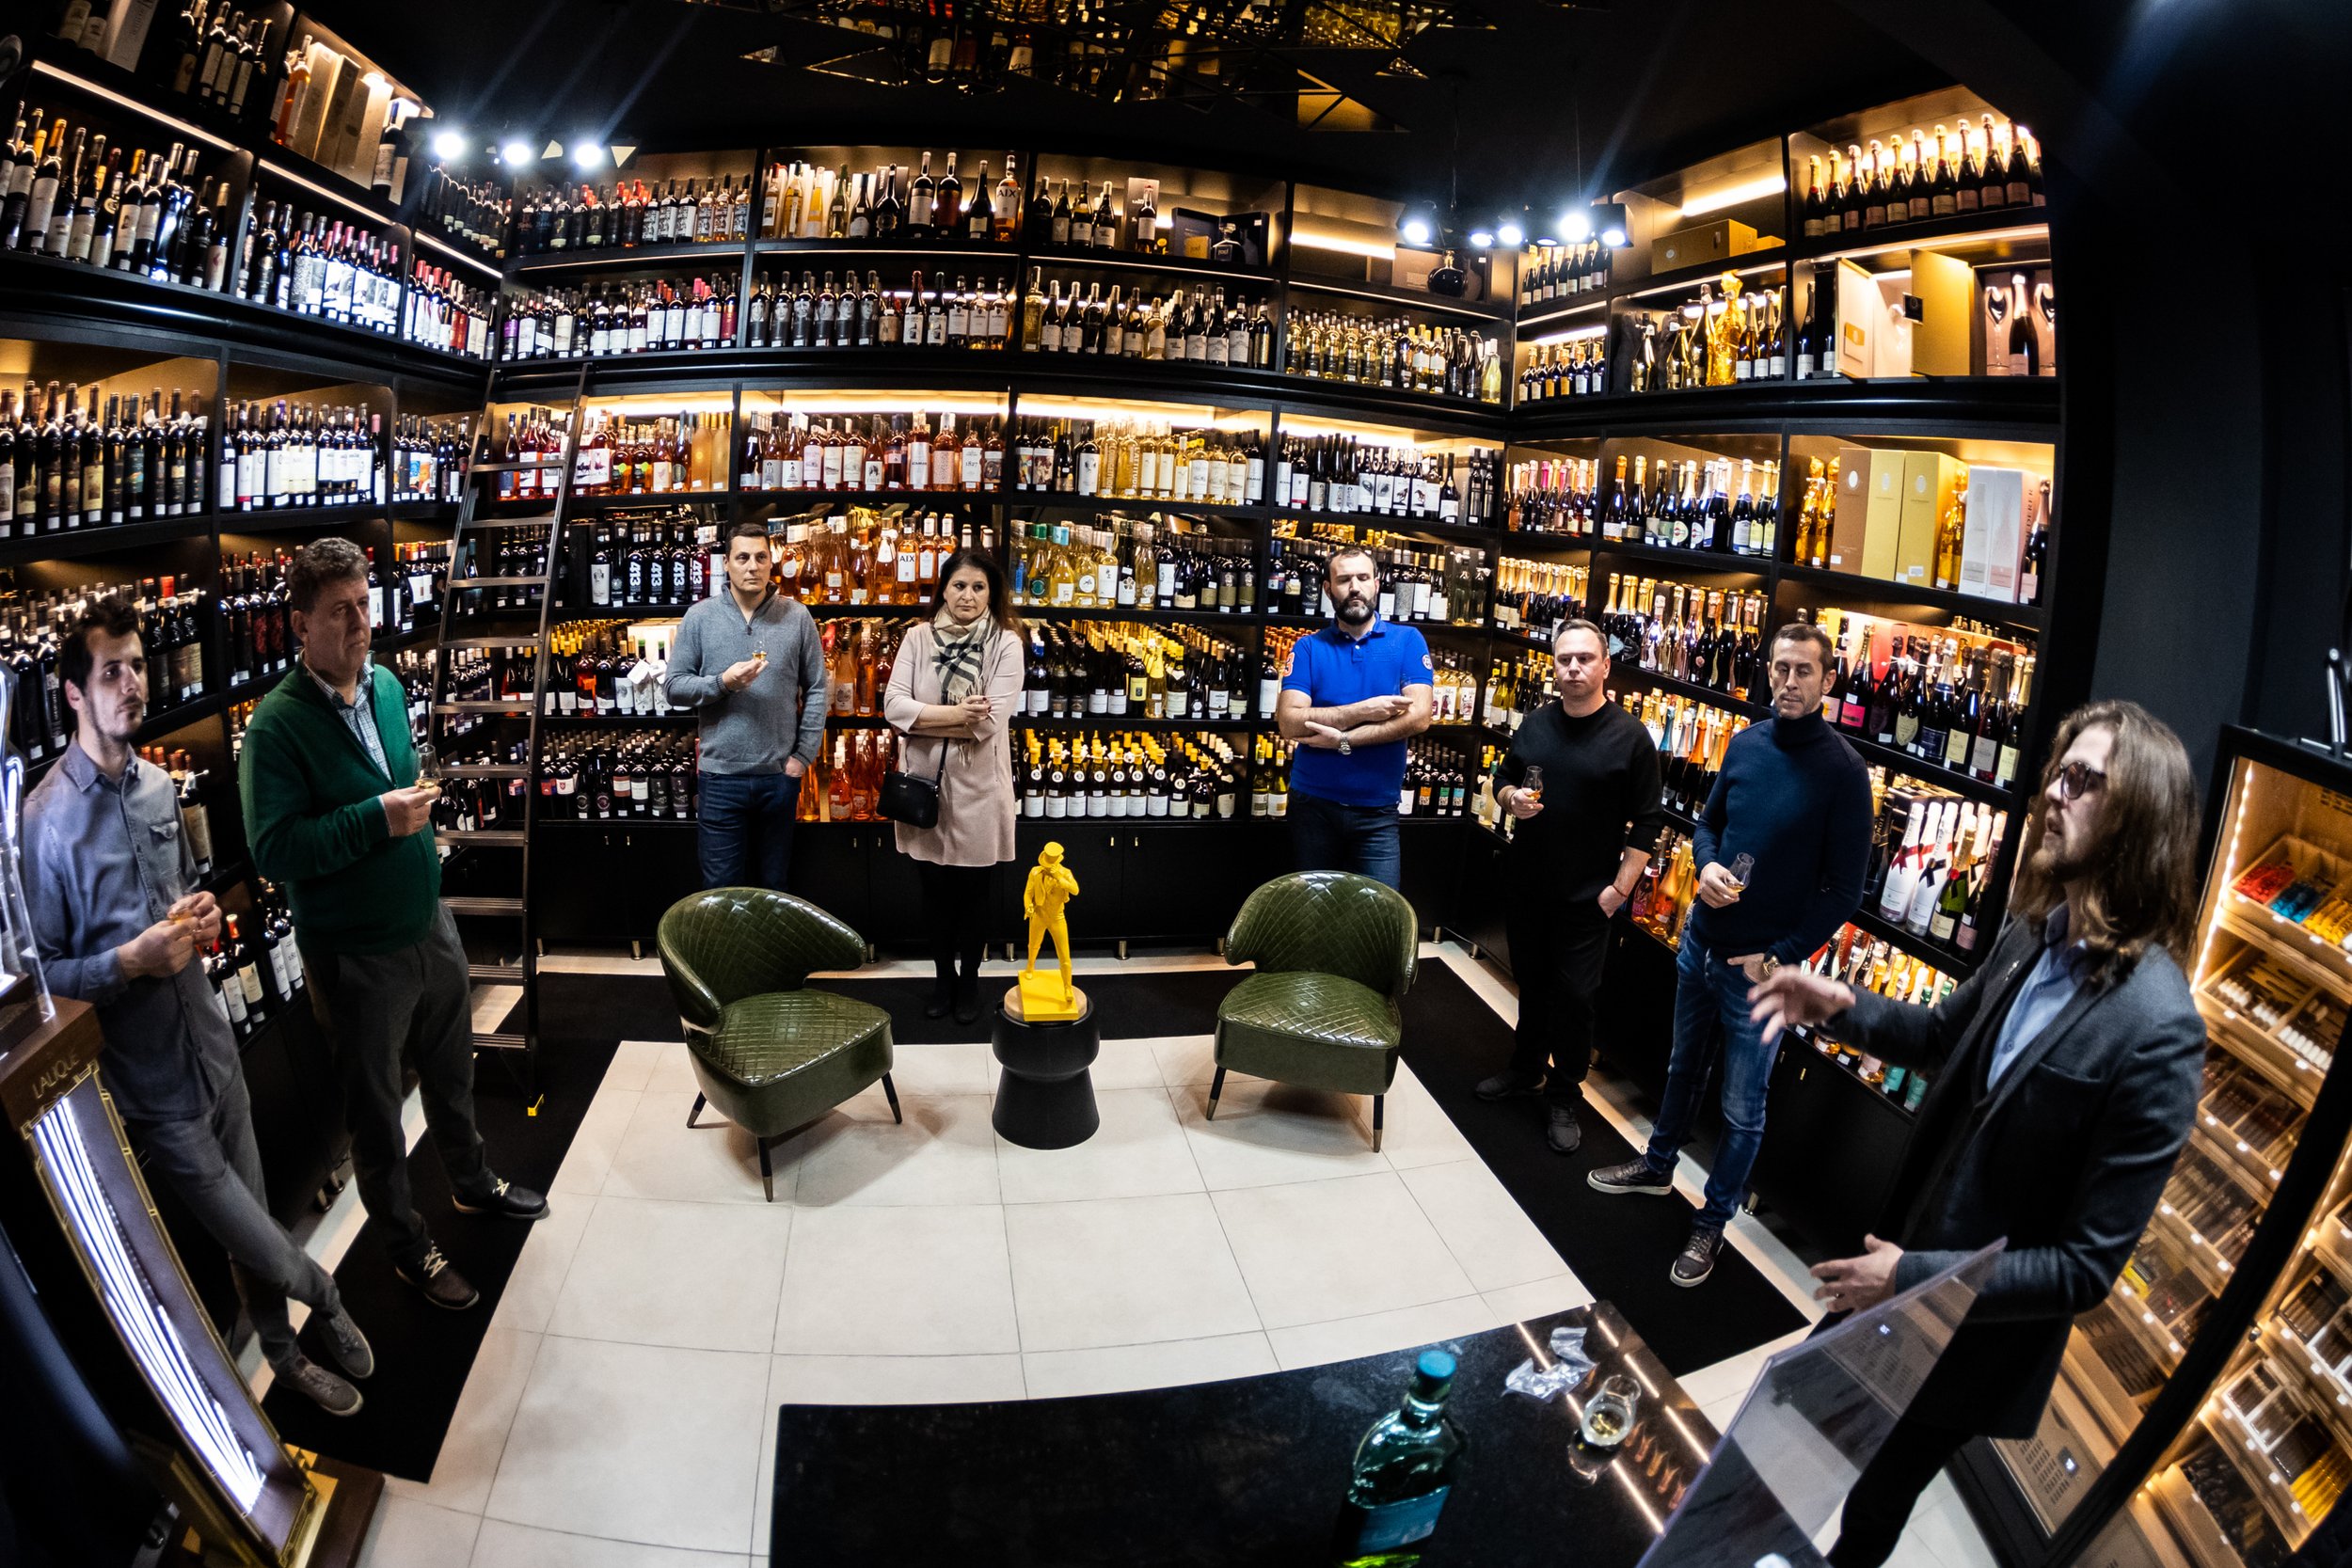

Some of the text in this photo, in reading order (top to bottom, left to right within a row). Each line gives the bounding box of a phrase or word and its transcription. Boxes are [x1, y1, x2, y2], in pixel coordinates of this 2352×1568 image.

[997, 188, 1016, 198] AIX
[629, 562, 642, 587] 413
[650, 562, 662, 587] 413
[673, 562, 685, 587] 413
[691, 560, 703, 585] 413
[32, 1048, 81, 1100] LALIQUE
